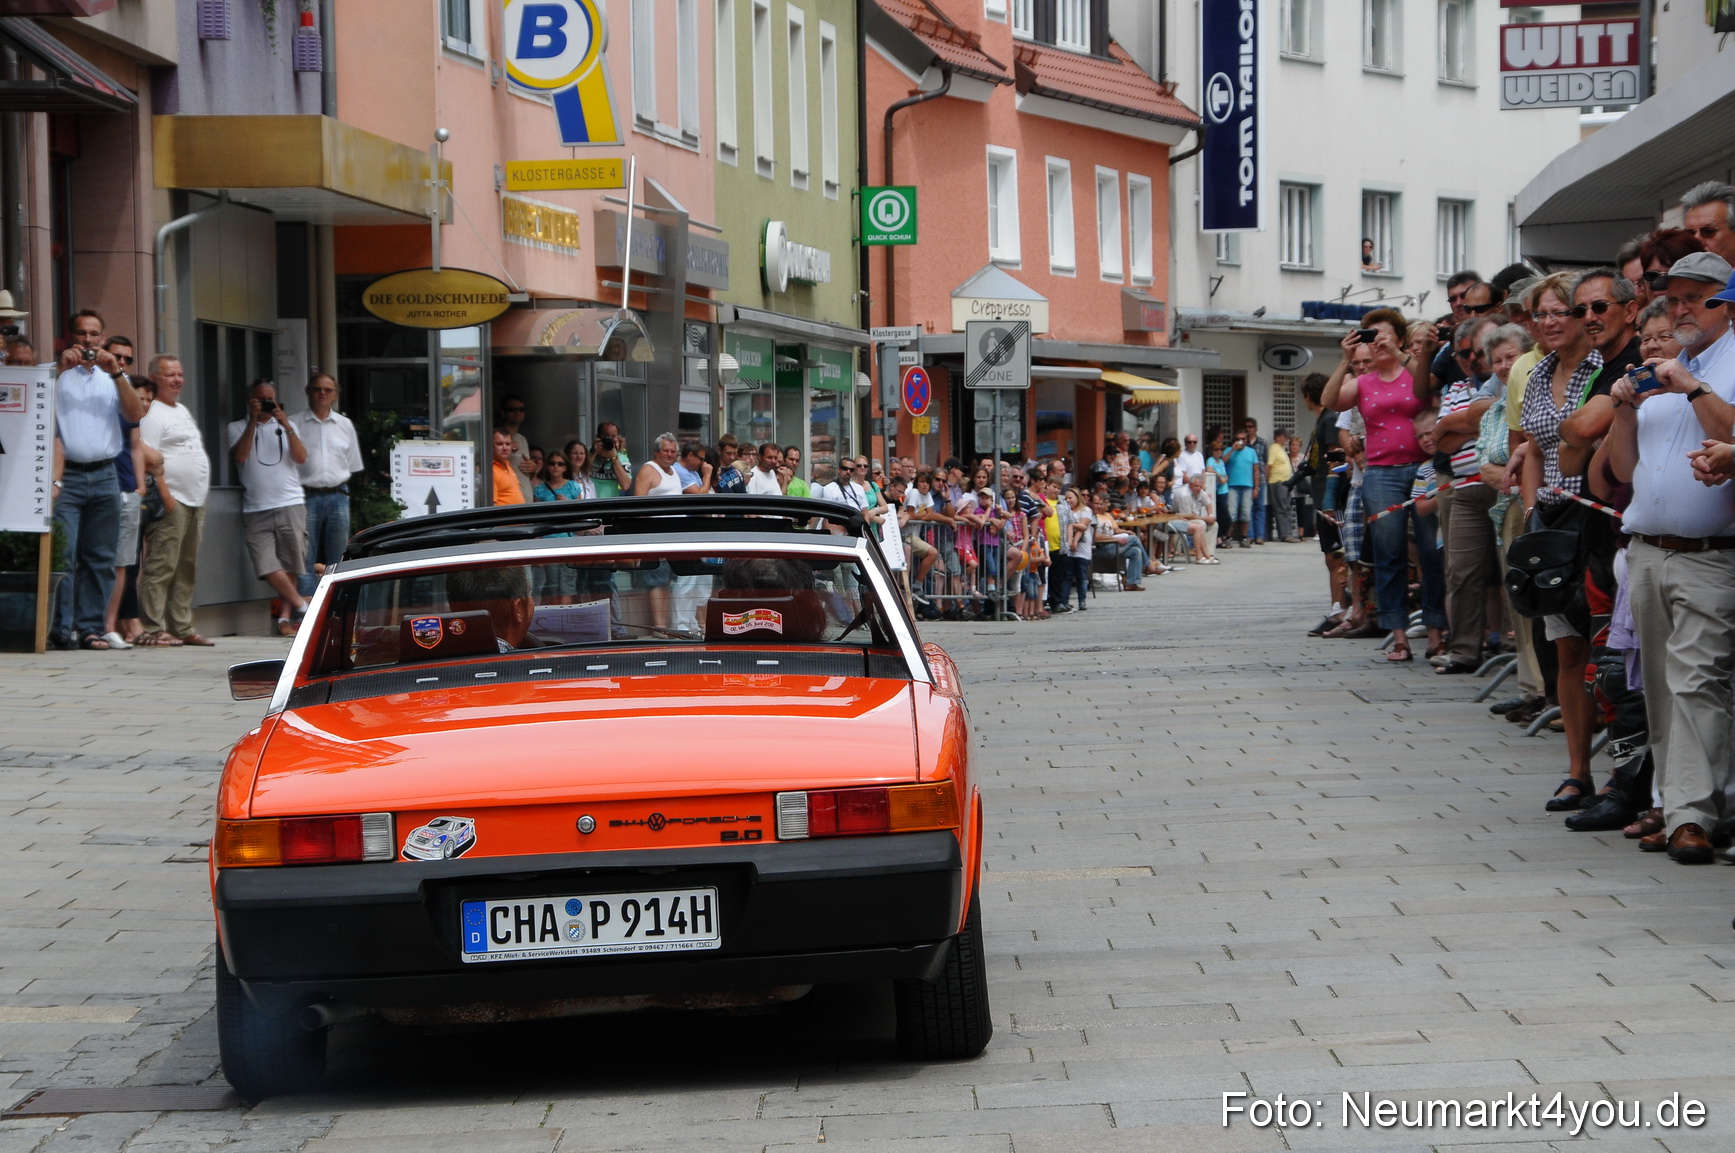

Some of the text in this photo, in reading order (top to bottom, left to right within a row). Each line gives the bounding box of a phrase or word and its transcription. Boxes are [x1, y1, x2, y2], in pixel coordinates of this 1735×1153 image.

[515, 3, 567, 60] B
[1505, 22, 1634, 68] WITT
[1238, 116, 1254, 207] TOM
[512, 167, 617, 182] KLOSTERGASSE 4
[369, 292, 507, 305] DIE GOLDSCHMIEDE
[433, 310, 467, 318] ROTHER
[872, 328, 912, 338] Klostergasse
[981, 370, 1013, 381] ZONE
[34, 381, 46, 515] RESIDENZPLATZ
[666, 815, 762, 825] PORSCHE
[720, 829, 762, 841] 2.0
[490, 895, 712, 944] CHA P 914H
[471, 932, 480, 944] D
[528, 949, 578, 958] ServiceWerkstatt
